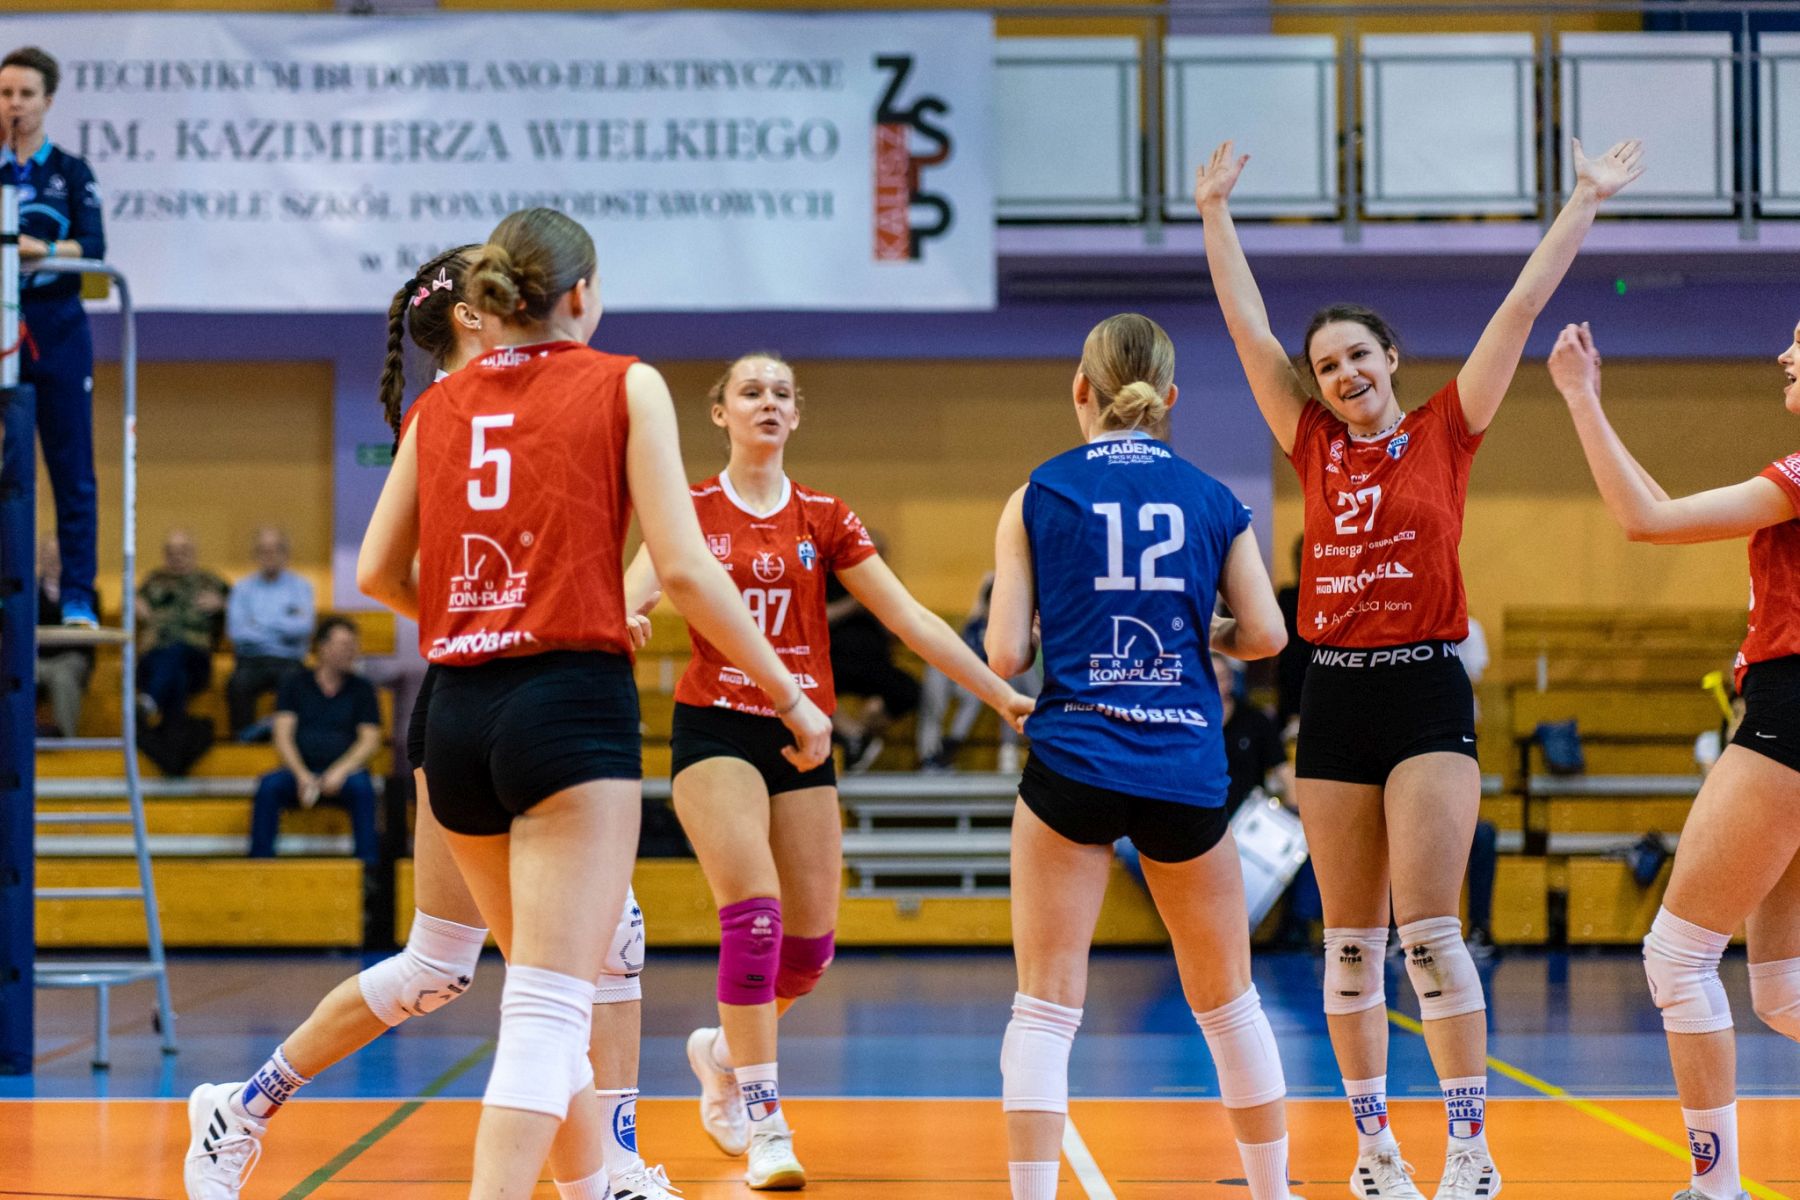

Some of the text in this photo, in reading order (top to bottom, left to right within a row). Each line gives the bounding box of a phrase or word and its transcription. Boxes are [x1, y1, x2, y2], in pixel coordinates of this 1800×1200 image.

[70, 59, 845, 92] TECHNIKUM BUDOWLANO-ELEKTRYCZNE
[79, 117, 840, 162] IM. KAZIMIERZA WIELKIEGO
[112, 190, 274, 222] ZESPOLE
[467, 414, 515, 511] 5
[1086, 442, 1172, 460] AKADEMIA
[1334, 484, 1382, 536] 27
[1092, 502, 1185, 591] 12
[1324, 543, 1363, 559] Energa
[1368, 538, 1394, 549] GRUPA
[742, 588, 792, 636] 97
[1384, 600, 1413, 611] Konin
[1089, 658, 1183, 668] GRUPA
[1313, 645, 1434, 668] NIKE PRO
[1089, 668, 1183, 681] KON-PLAST
[271, 1069, 295, 1092] MKS
[1444, 1087, 1485, 1097] ERGA
[1351, 1095, 1377, 1105] MKS
[1447, 1099, 1473, 1109] MKS
